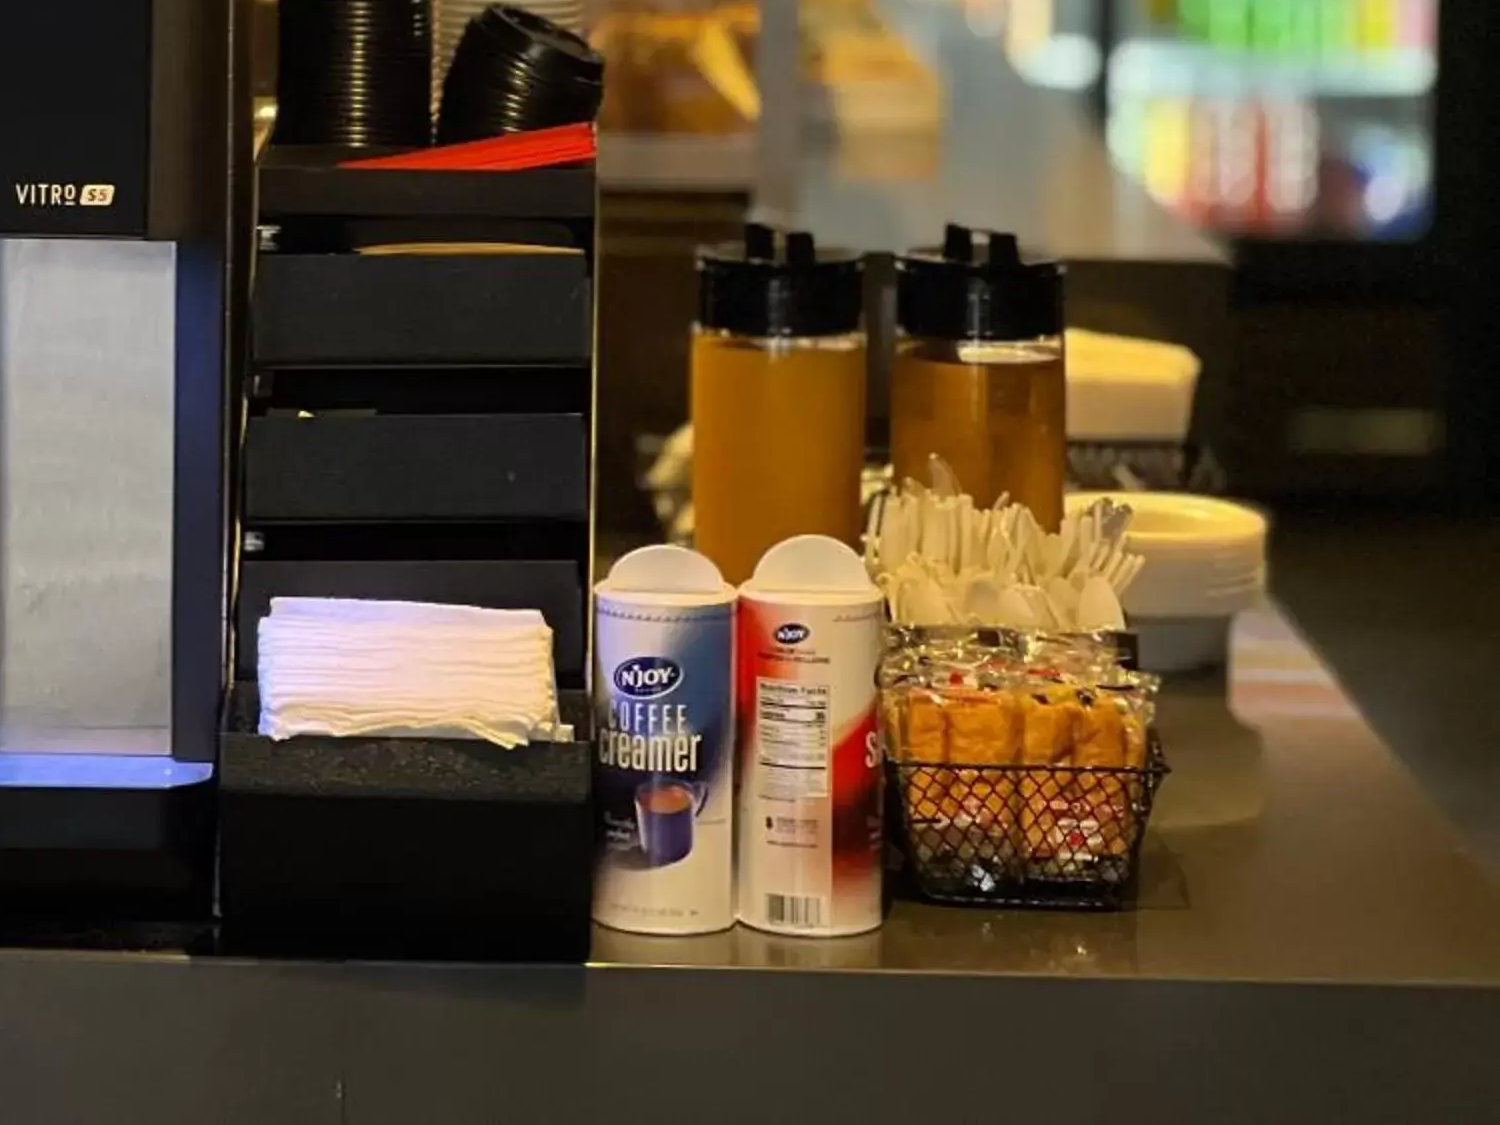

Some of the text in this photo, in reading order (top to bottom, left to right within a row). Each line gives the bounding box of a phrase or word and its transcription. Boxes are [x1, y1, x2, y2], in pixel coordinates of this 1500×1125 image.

[15, 183, 76, 206] VITRO
[607, 698, 687, 735] COFFEE
[599, 728, 703, 773] creamer
